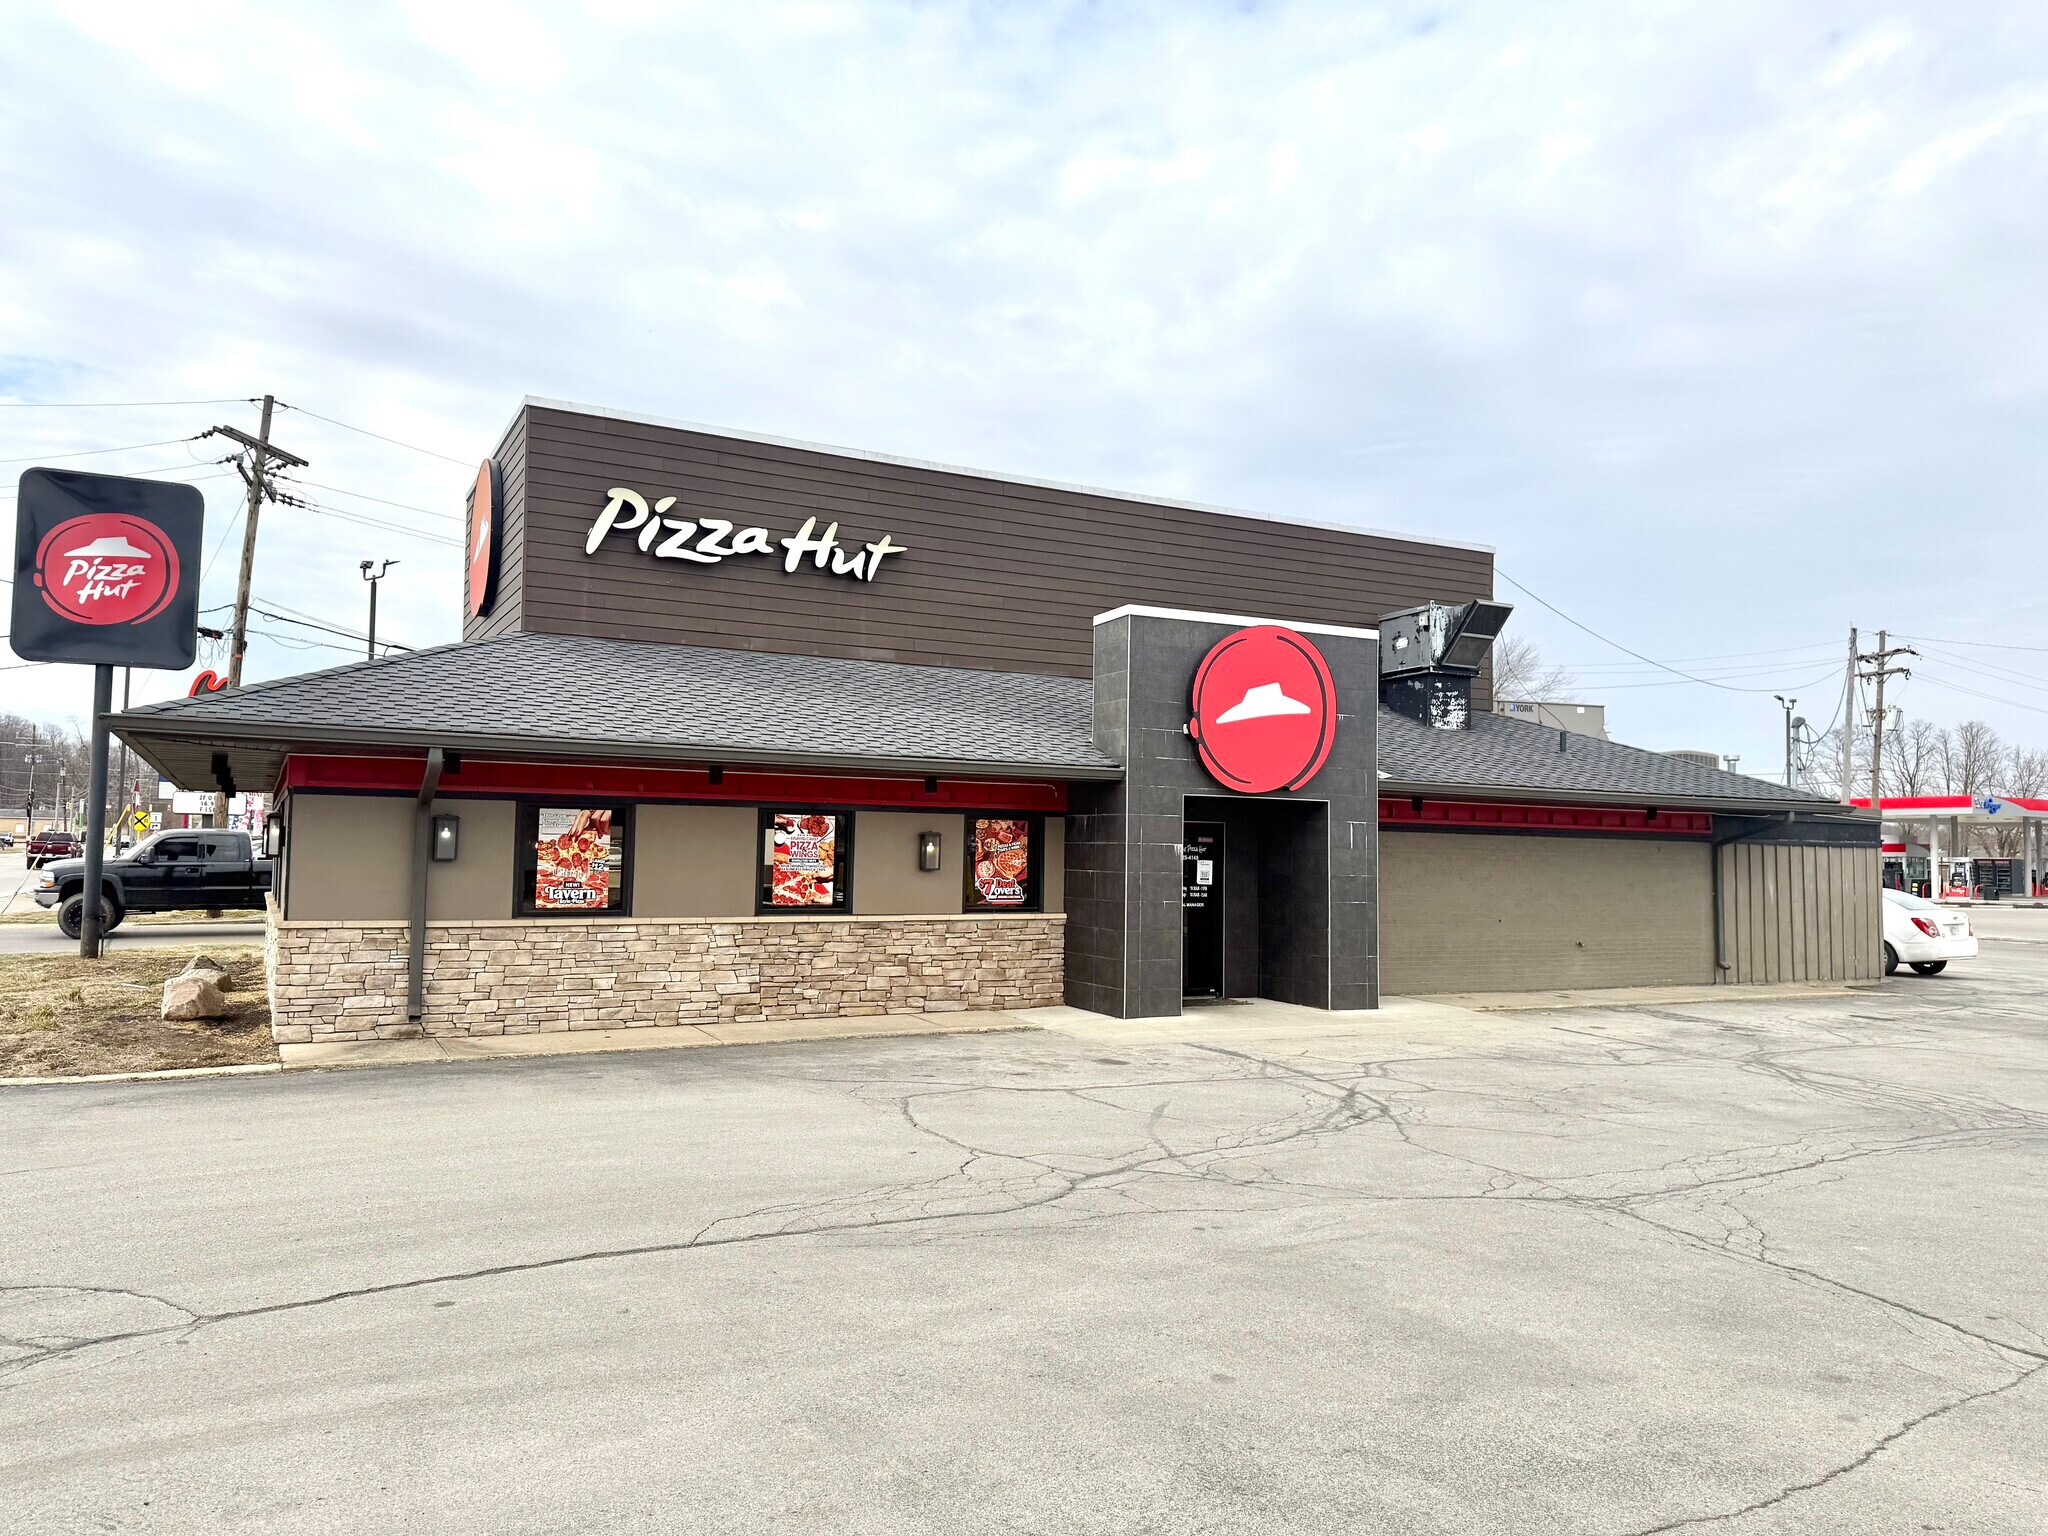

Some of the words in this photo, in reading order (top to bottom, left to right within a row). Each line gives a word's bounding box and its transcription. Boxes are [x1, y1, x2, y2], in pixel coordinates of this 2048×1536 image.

[584, 487, 774, 564] Pizza
[780, 515, 908, 583] Hut
[62, 557, 147, 587] Pizza
[76, 579, 142, 604] Hut
[1515, 704, 1534, 713] YORK
[790, 841, 818, 850] PIZZA
[790, 850, 818, 858] WINGS
[979, 879, 994, 895] $7
[996, 879, 1015, 888] Deal
[544, 886, 597, 900] Tavern
